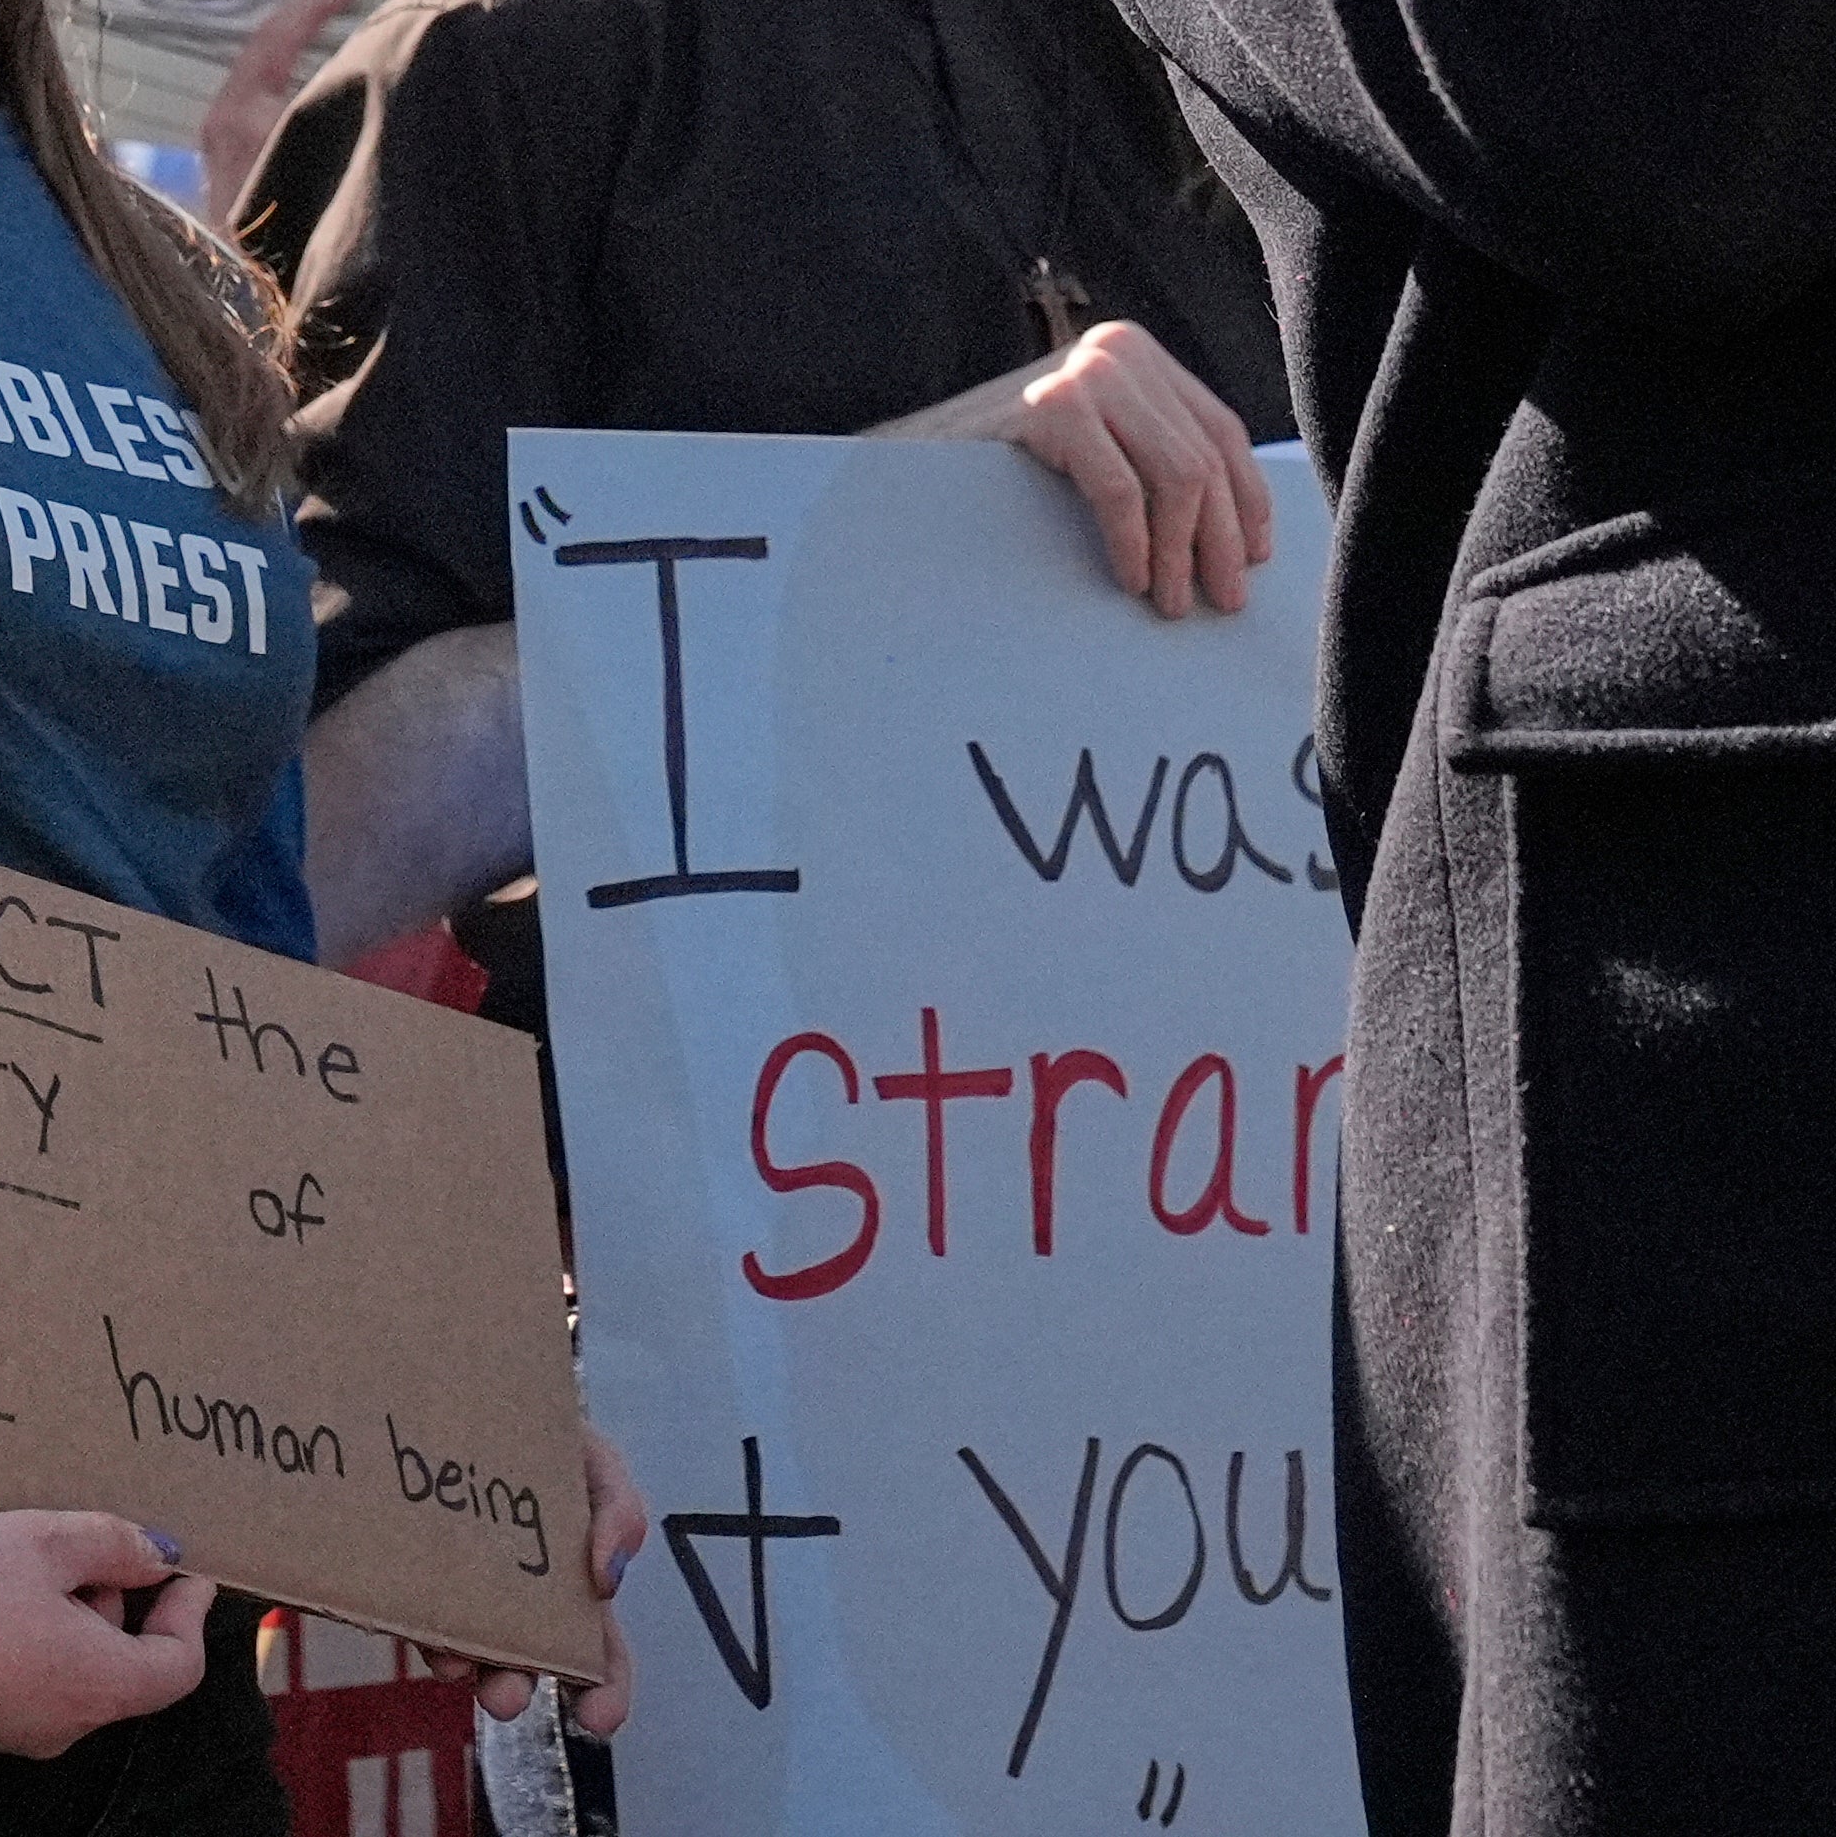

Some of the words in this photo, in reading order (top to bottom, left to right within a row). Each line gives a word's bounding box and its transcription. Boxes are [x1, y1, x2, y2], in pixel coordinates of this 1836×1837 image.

[196, 966, 361, 1104] the
[250, 1172, 326, 1246] of
[104, 1314, 346, 1478] human
[387, 1414, 553, 1577] being
[956, 1435, 1332, 1779] you
